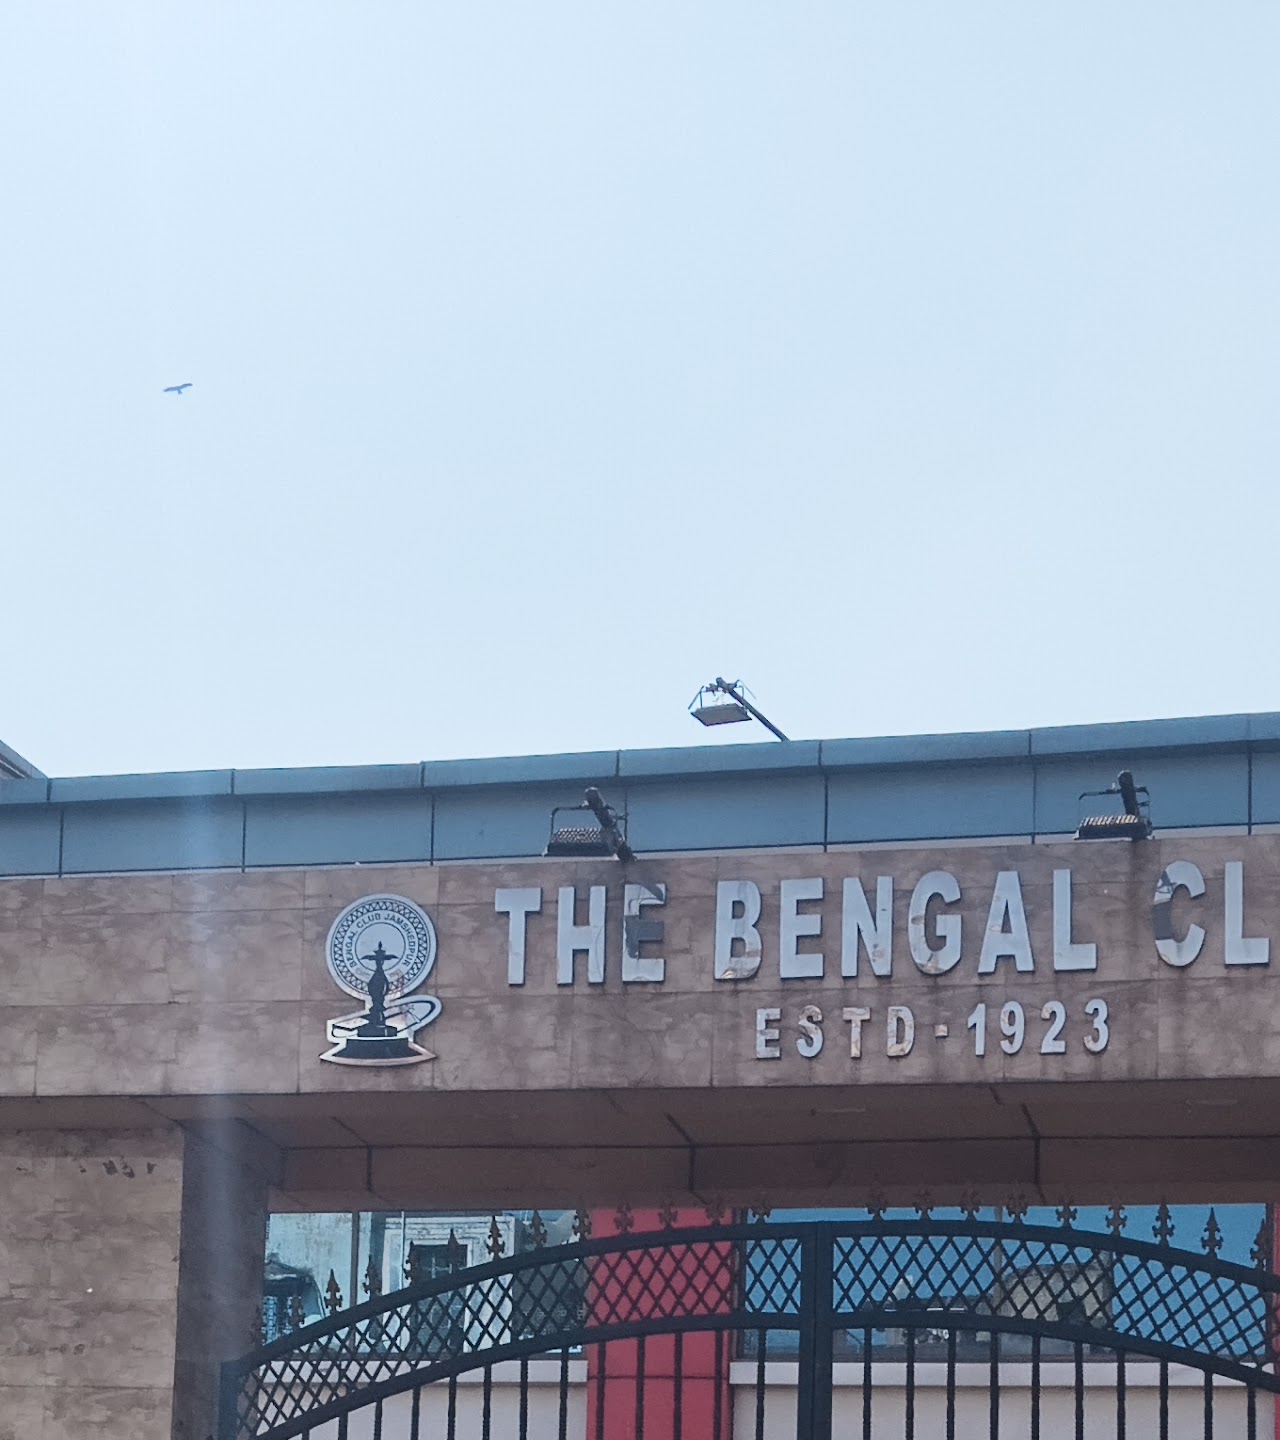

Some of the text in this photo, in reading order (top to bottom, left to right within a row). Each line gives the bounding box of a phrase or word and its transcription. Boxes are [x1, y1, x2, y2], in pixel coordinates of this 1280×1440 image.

[356, 913, 382, 929] CLUB
[383, 912, 417, 968] JAMSHEDPUR
[494, 883, 665, 986] THE
[714, 868, 1098, 980] BENGAL
